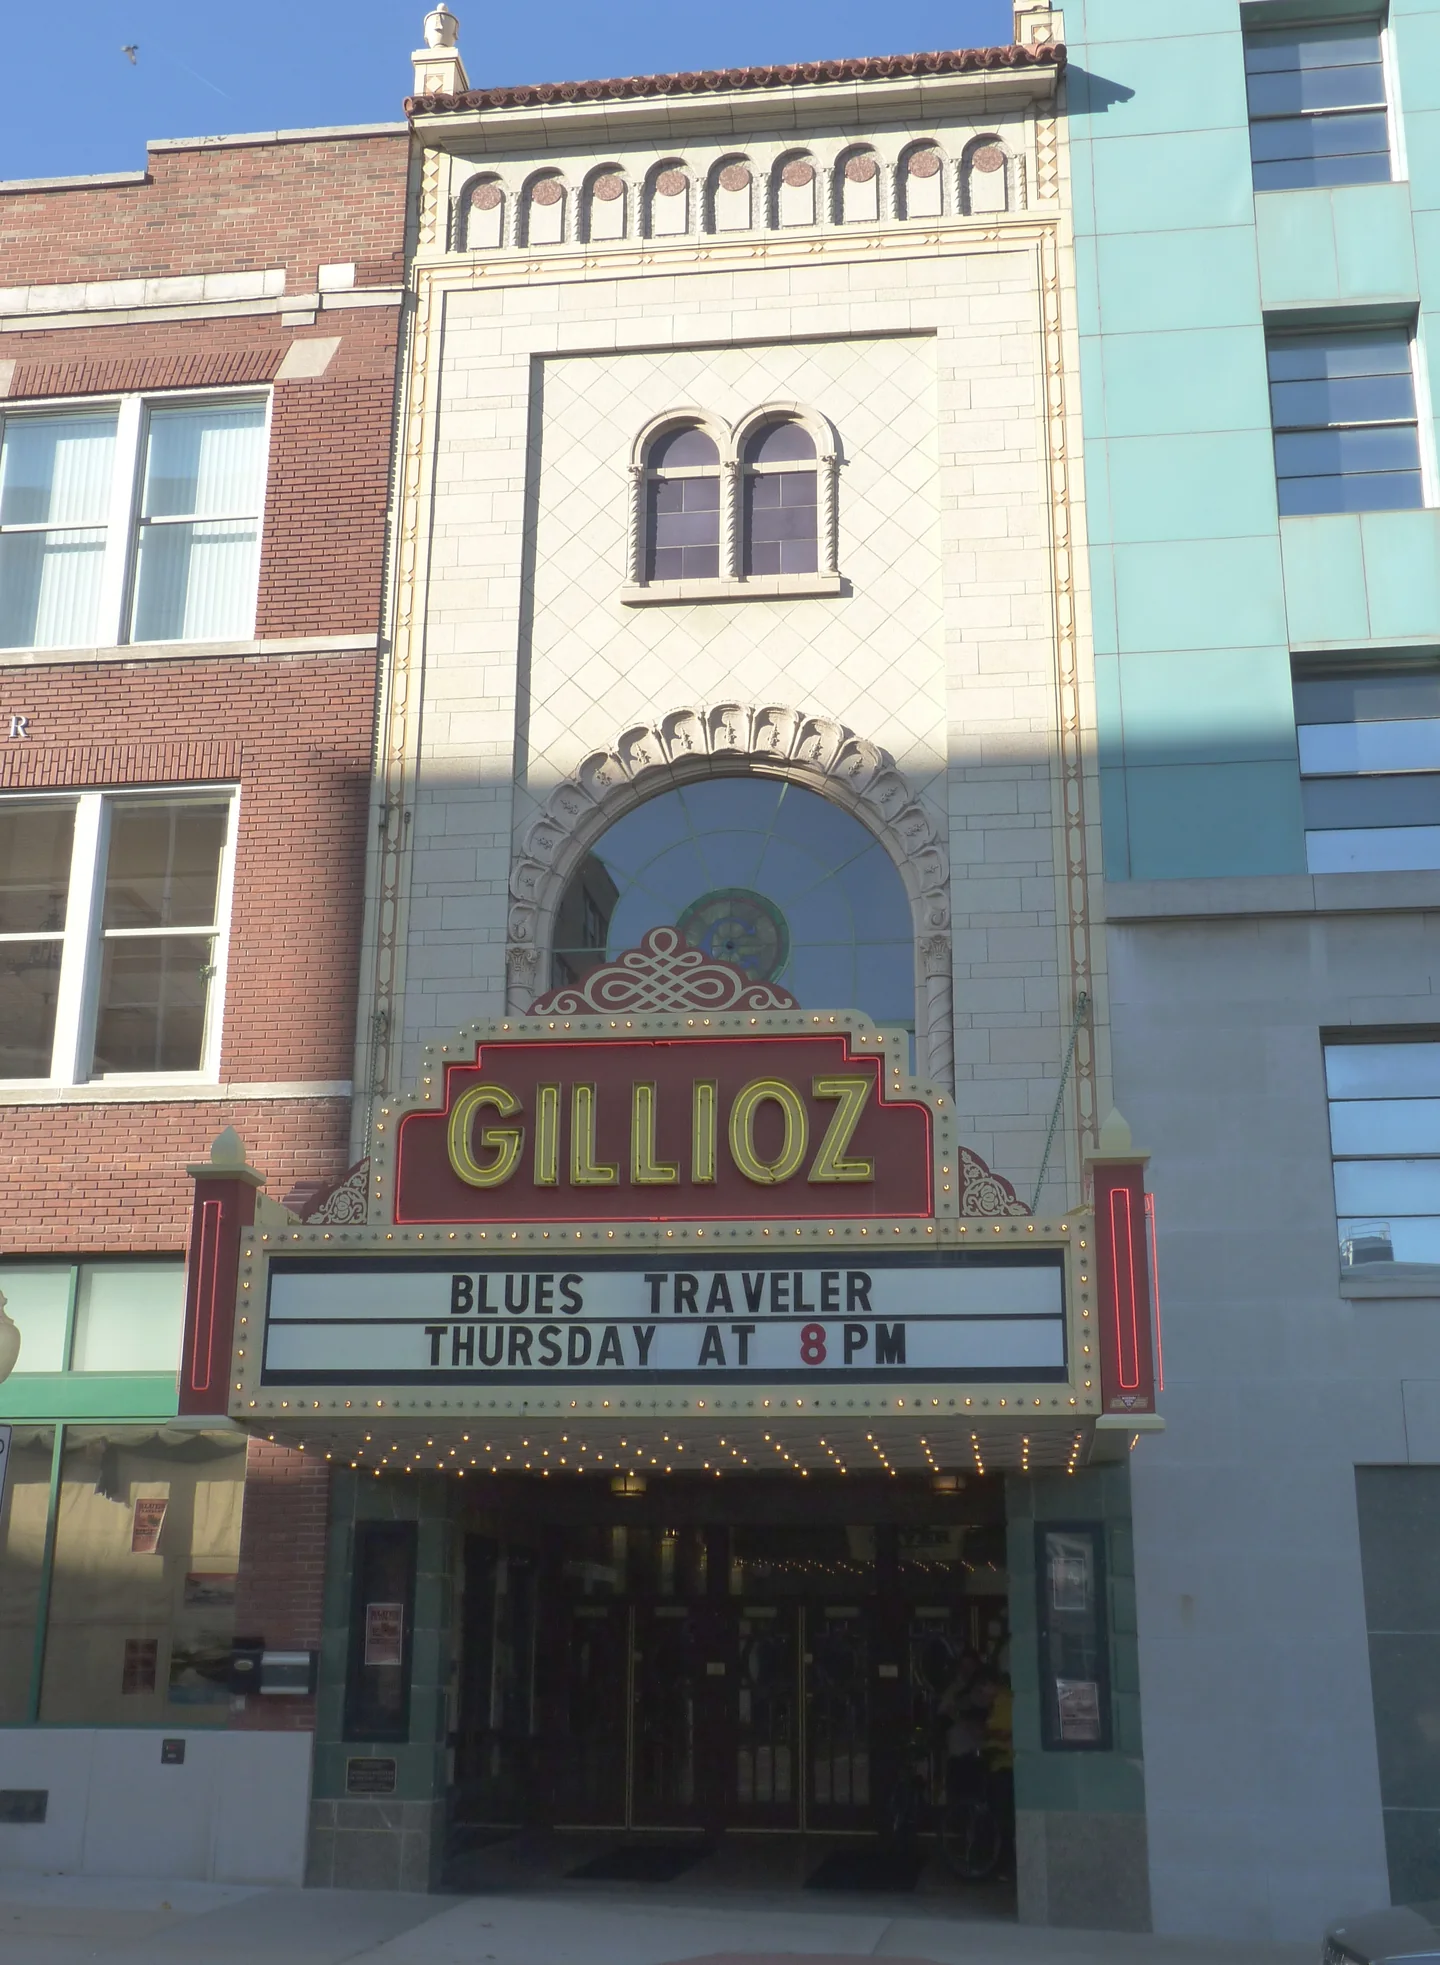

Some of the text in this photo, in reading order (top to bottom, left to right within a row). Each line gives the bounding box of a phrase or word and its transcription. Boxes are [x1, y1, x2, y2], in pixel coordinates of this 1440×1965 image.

[9, 715, 30, 738] R
[447, 1074, 876, 1187] GILLIOZ
[450, 1271, 872, 1315] BLUES TRAVELER
[424, 1324, 656, 1367] THURSDAY
[697, 1324, 756, 1366] AT
